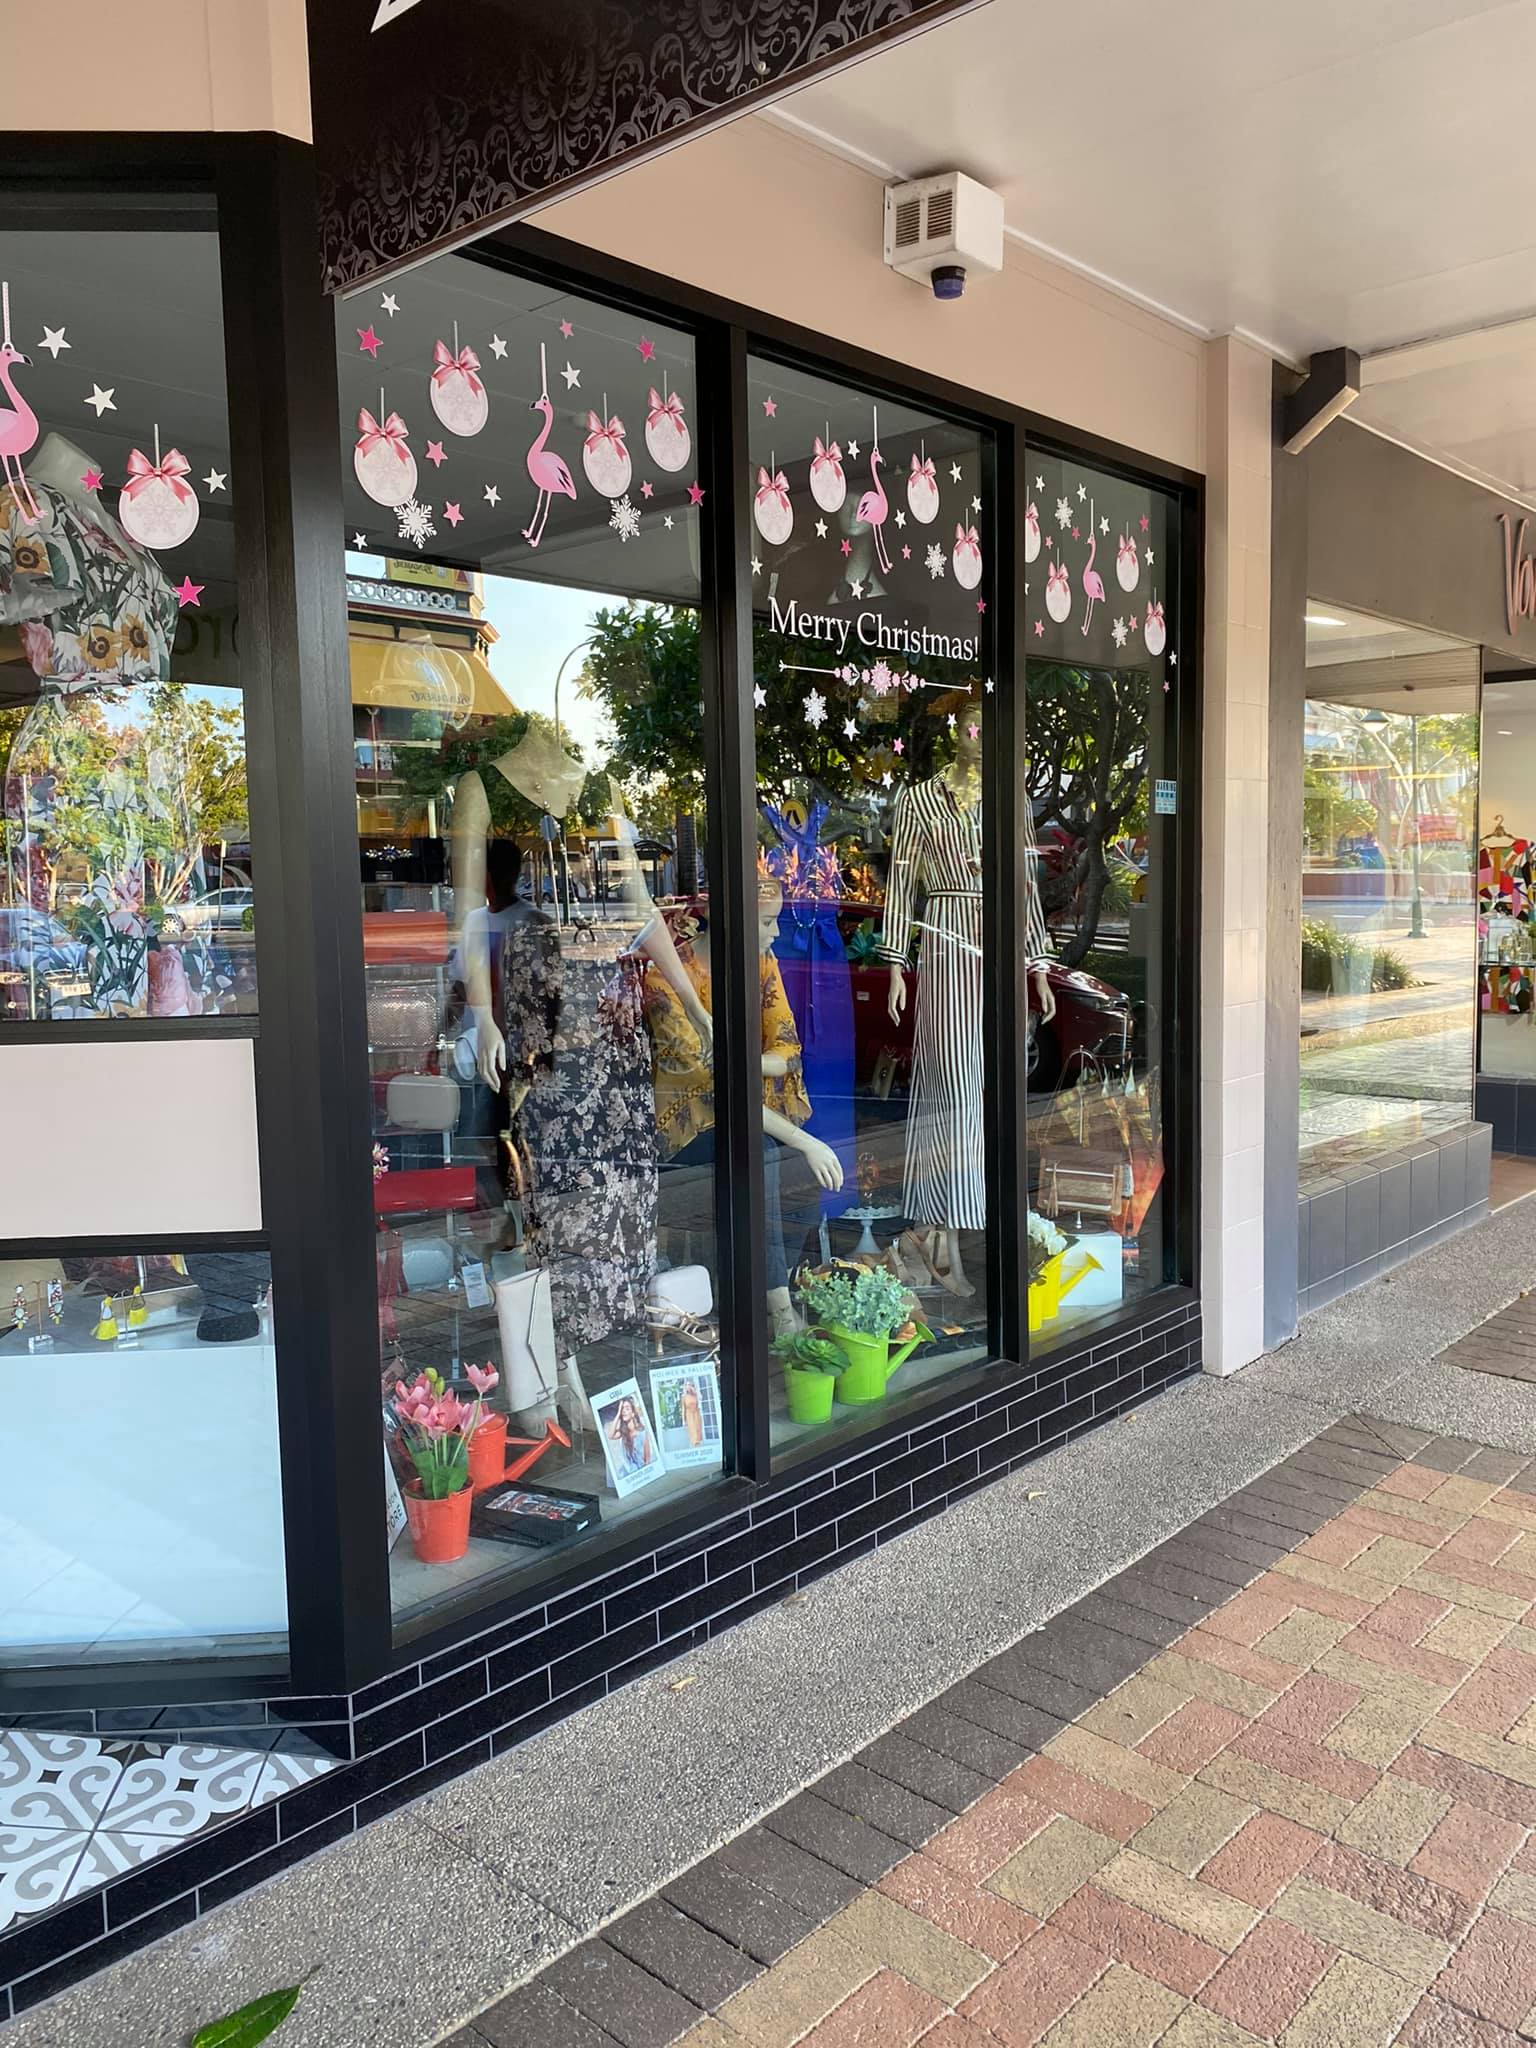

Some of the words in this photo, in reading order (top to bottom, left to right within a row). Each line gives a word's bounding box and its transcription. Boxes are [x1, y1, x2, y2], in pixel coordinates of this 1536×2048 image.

[1498, 514, 1536, 636] Va
[768, 596, 851, 655] Merry
[857, 612, 979, 662] Christmas!
